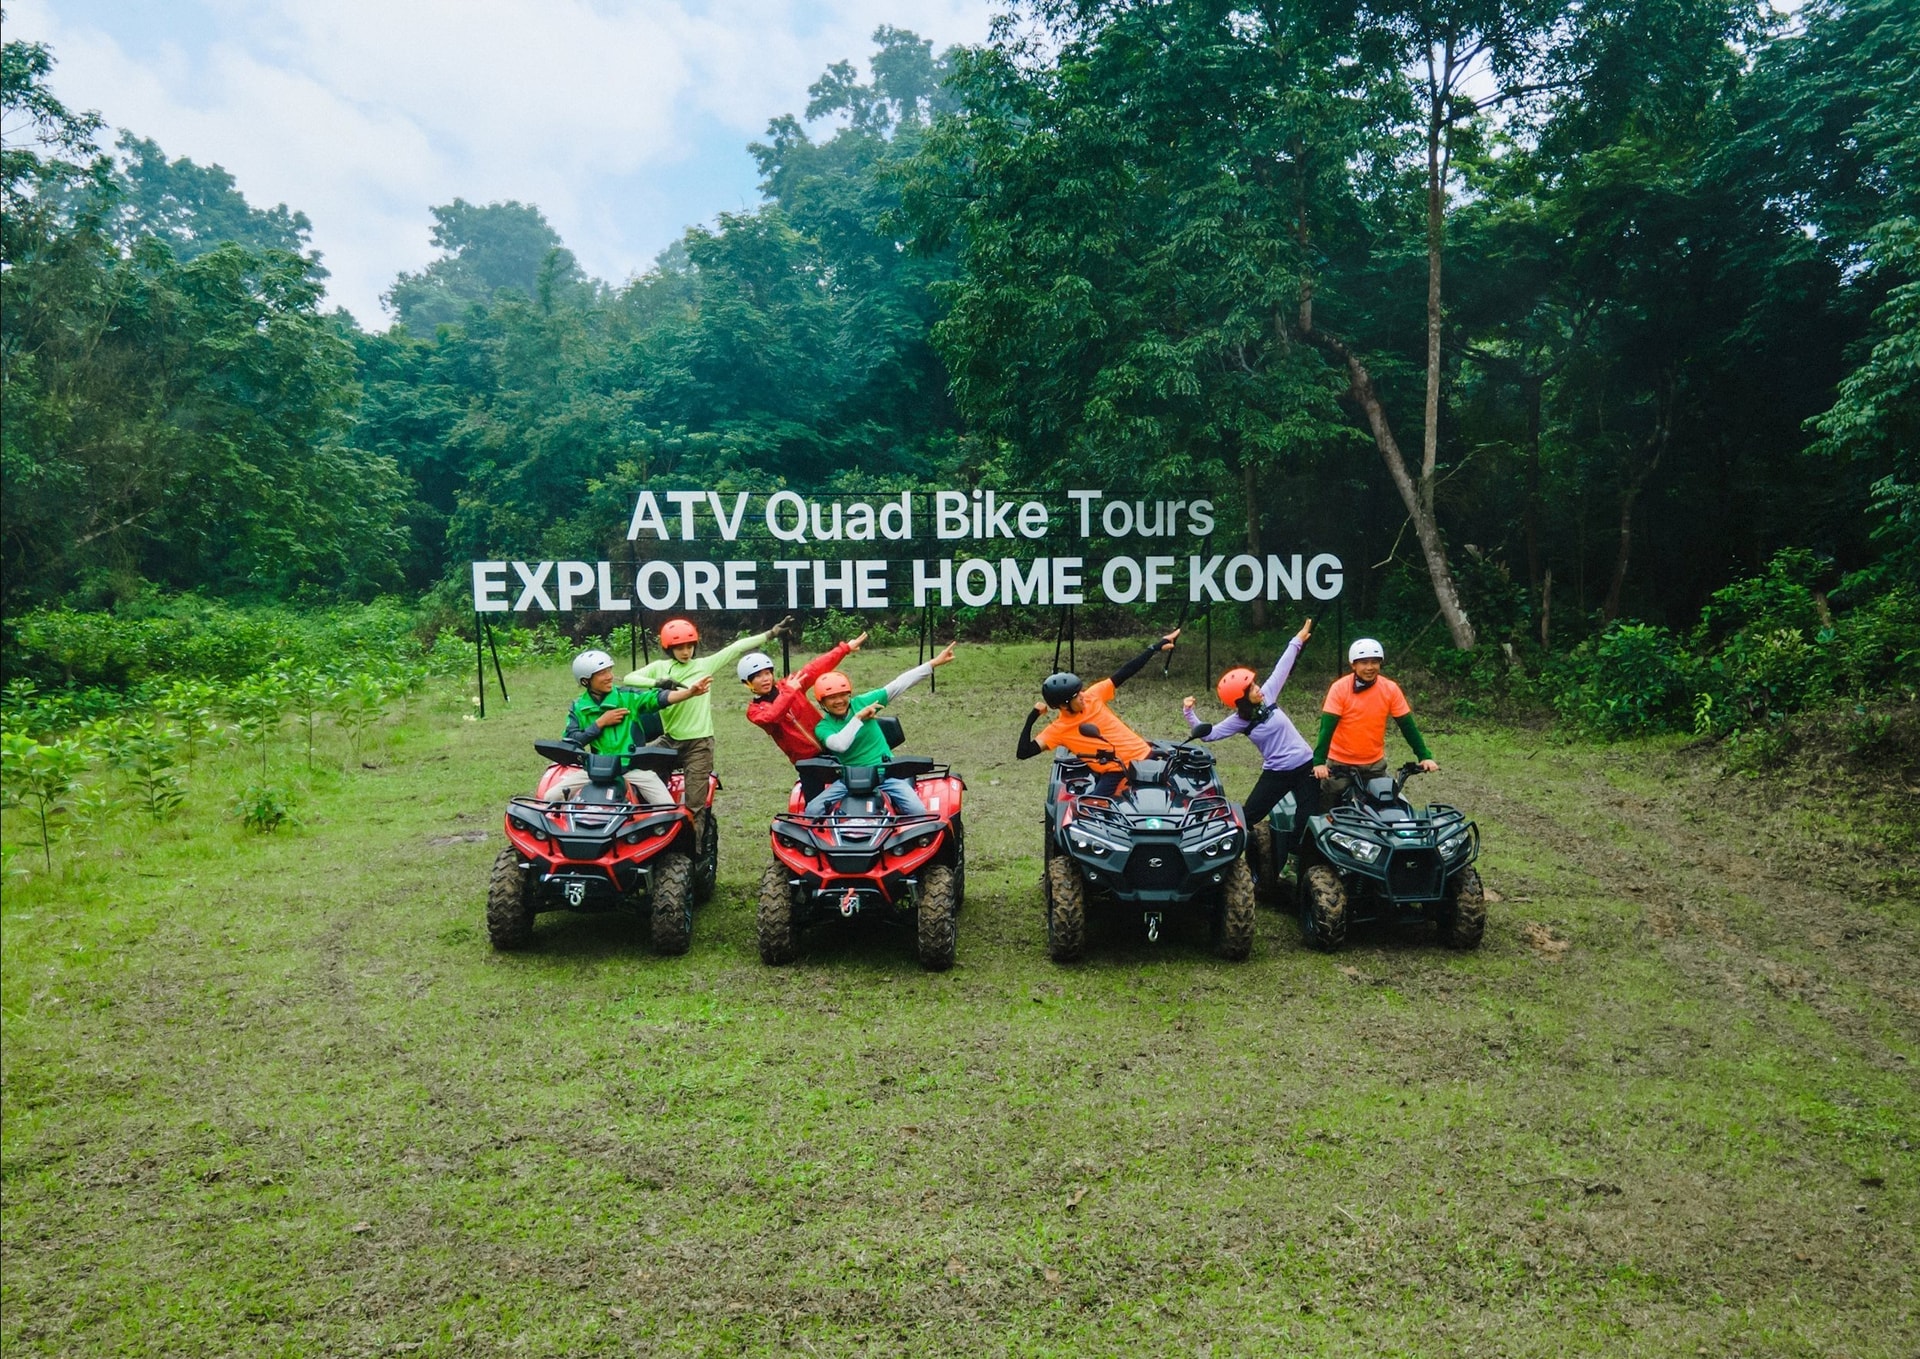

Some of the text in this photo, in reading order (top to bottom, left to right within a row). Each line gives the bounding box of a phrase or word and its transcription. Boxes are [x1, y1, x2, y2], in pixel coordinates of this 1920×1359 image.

[627, 488, 1215, 544] ATV Quad Bike Tours
[472, 553, 1344, 612] EXPLORE THE HOME OF KONG
